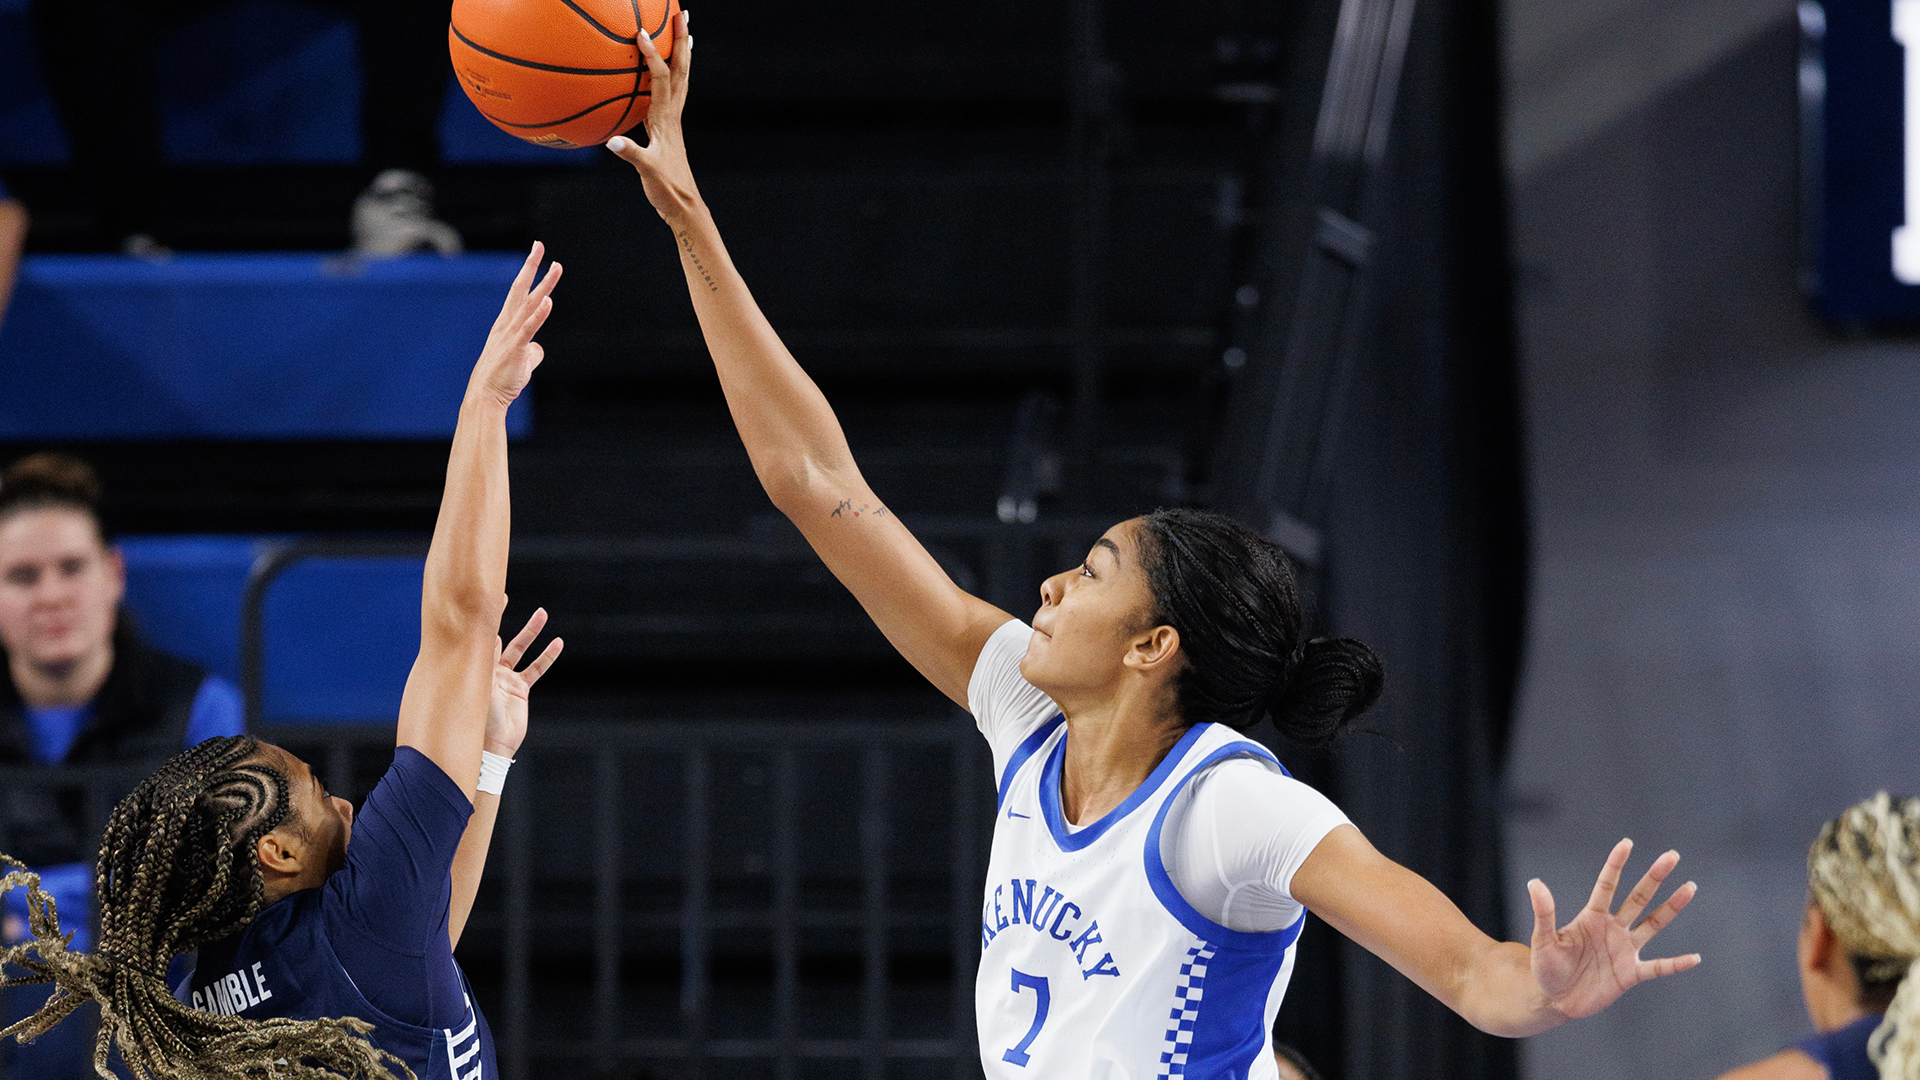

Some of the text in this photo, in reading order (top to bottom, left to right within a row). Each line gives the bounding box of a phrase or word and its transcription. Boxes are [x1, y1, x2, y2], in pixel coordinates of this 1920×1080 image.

[982, 878, 1121, 981] KENUCKY
[192, 961, 273, 1016] GAMBLE
[1002, 967, 1051, 1068] 7
